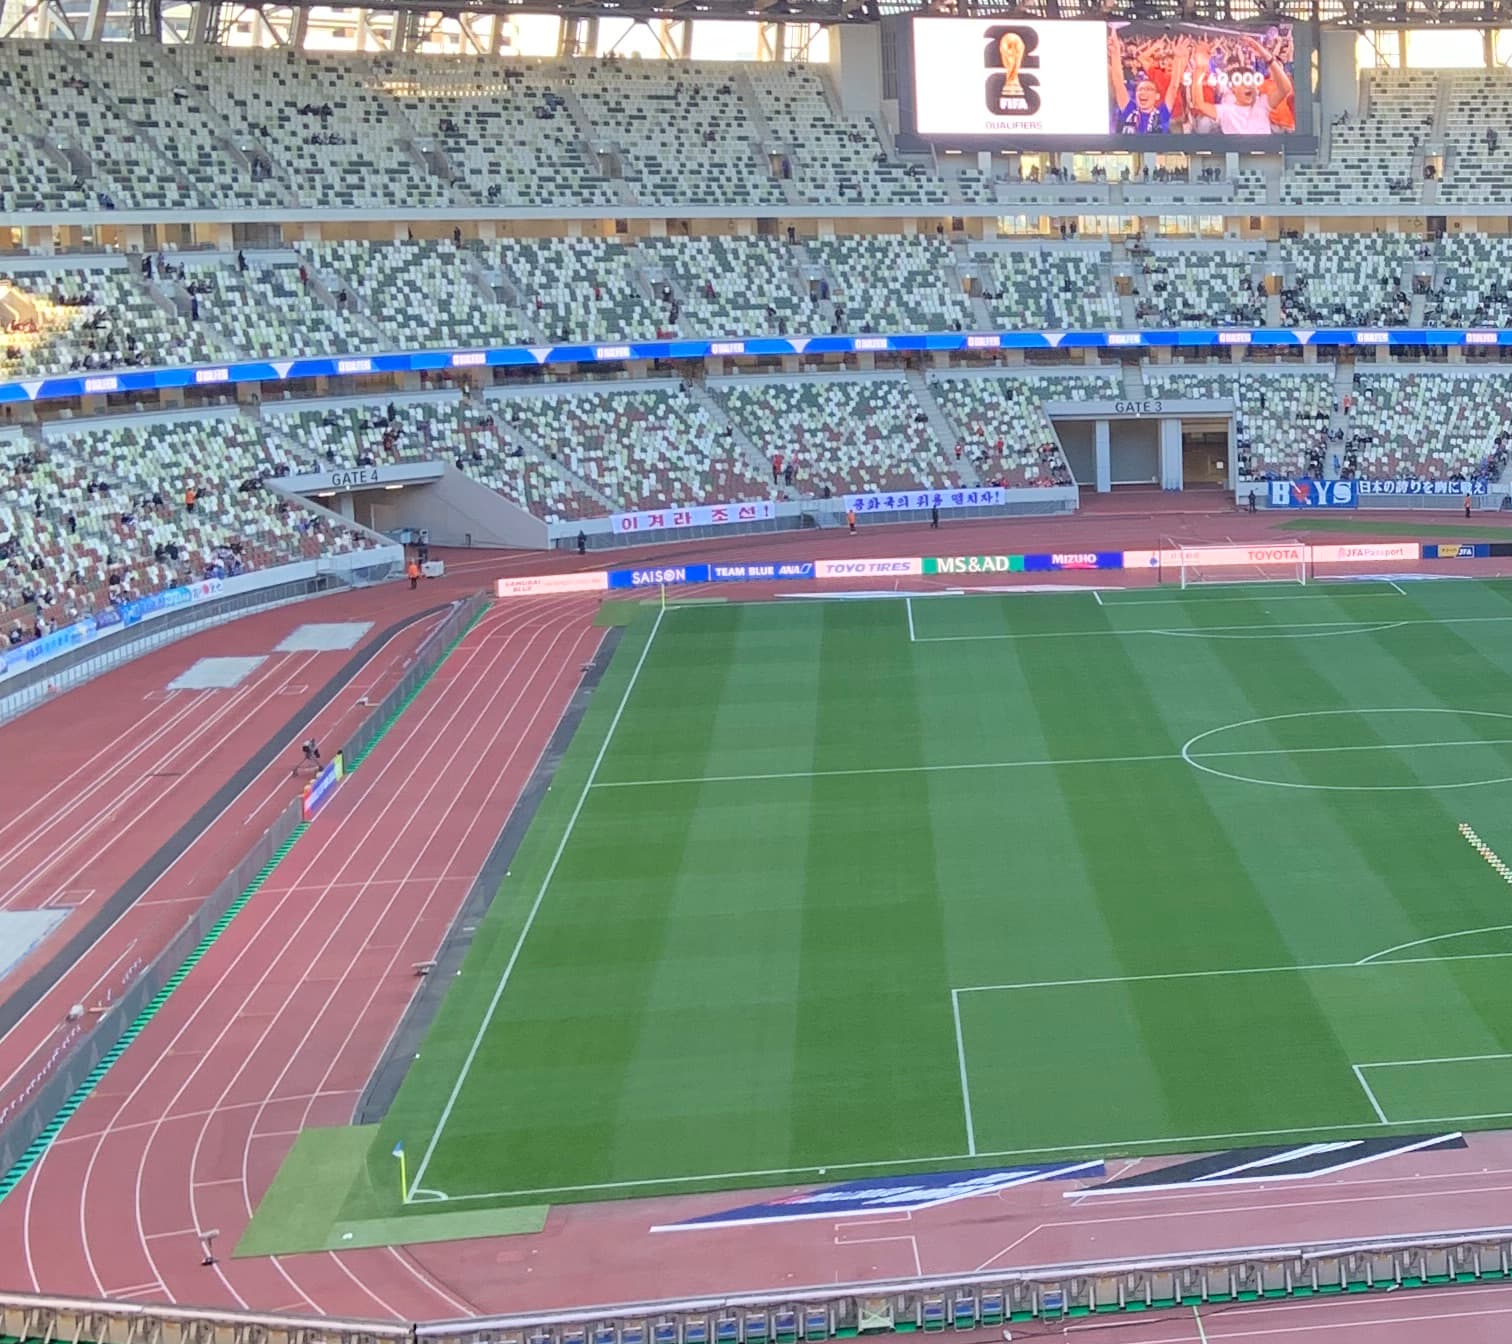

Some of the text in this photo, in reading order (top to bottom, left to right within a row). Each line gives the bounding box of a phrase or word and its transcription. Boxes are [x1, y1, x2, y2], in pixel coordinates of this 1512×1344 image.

[999, 97, 1028, 110] FIFA
[985, 120, 1042, 130] QUALIFIERS
[1115, 401, 1162, 413] GATE 3
[332, 469, 378, 486] GATE 4
[622, 512, 692, 530] 이겨라
[1051, 553, 1097, 564] MIZUHO
[1247, 550, 1299, 561] TOYOTA
[826, 561, 911, 573] TOYO TIRES
[936, 556, 1010, 573] MS&AD
[631, 568, 686, 585] SAISON
[715, 567, 745, 577] TEAM
[748, 566, 774, 576] BLUE
